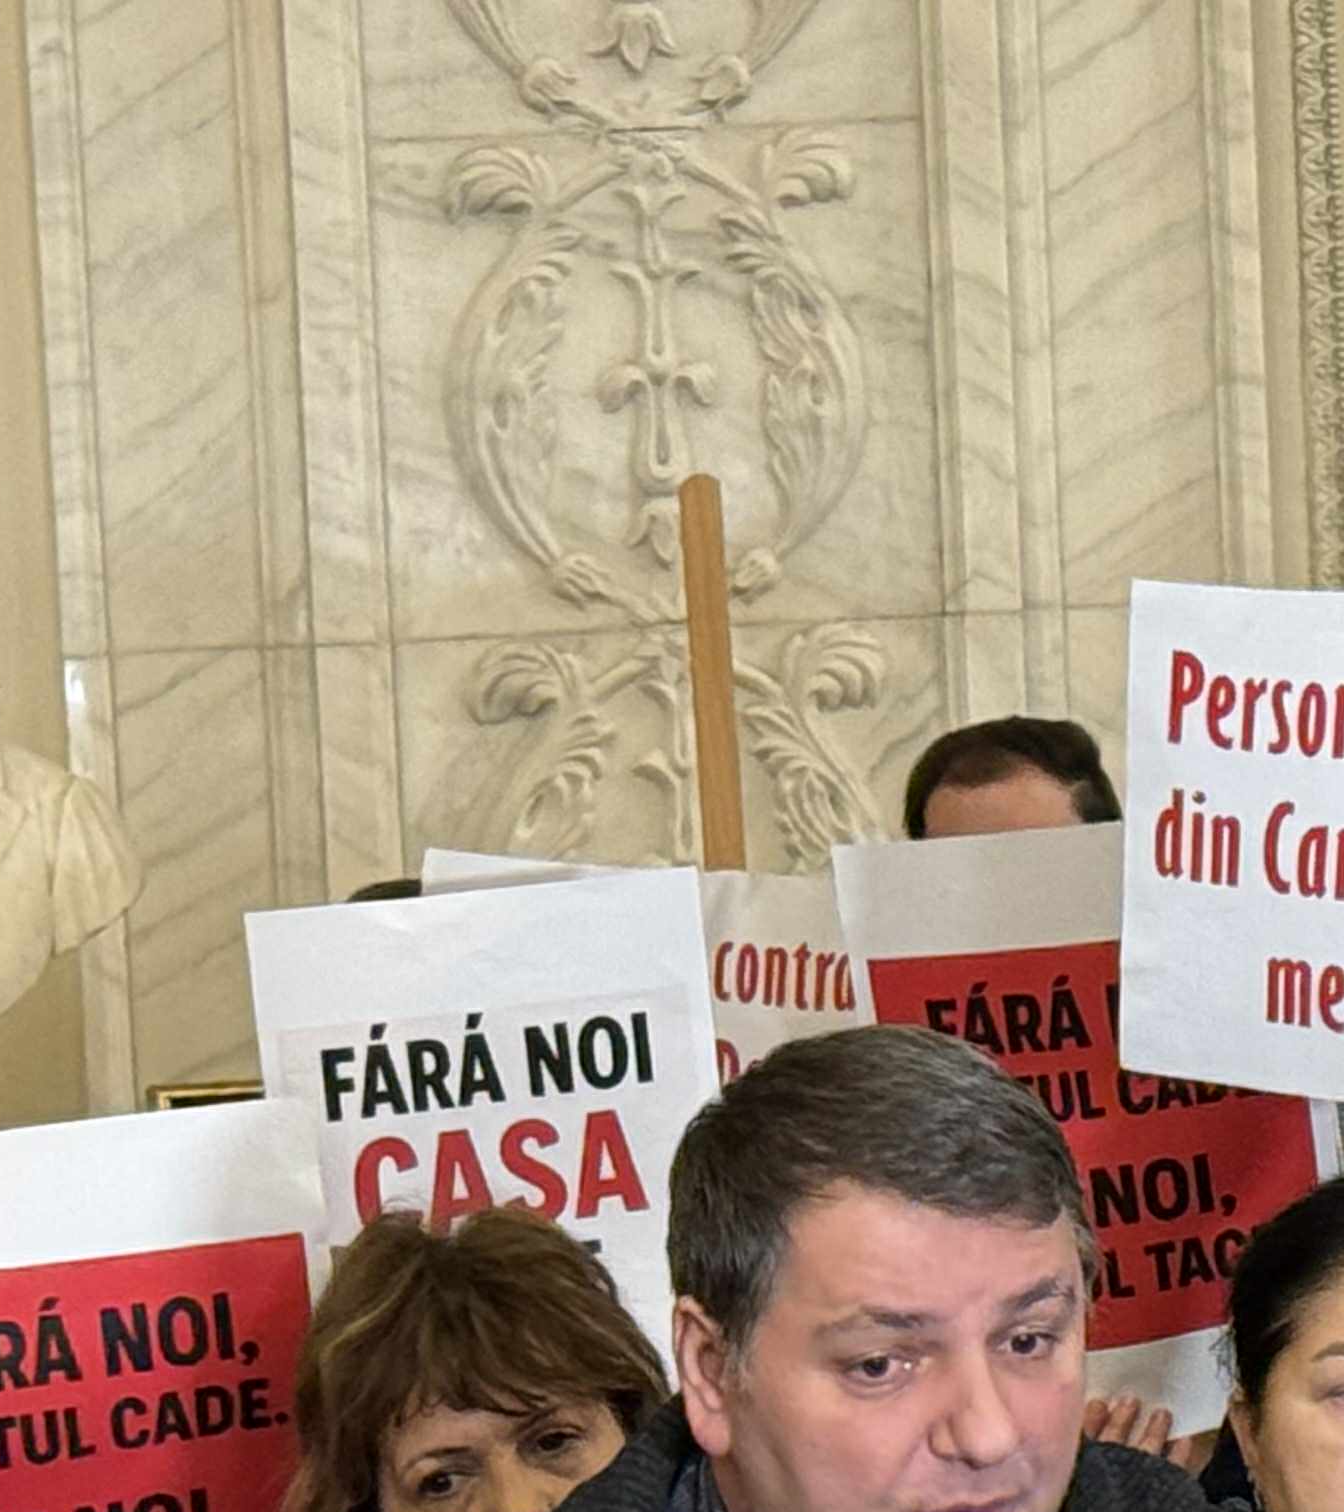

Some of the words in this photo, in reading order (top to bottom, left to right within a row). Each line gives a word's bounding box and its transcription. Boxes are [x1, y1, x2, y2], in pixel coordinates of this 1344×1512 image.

[1155, 789, 1240, 887] din
[713, 941, 856, 1012] contra
[523, 1012, 653, 1097] NOI
[354, 1109, 650, 1237] CASA
[1088, 1153, 1237, 1229] NOI,
[100, 1292, 260, 1377] NOI,
[110, 1377, 289, 1450] CADE.
